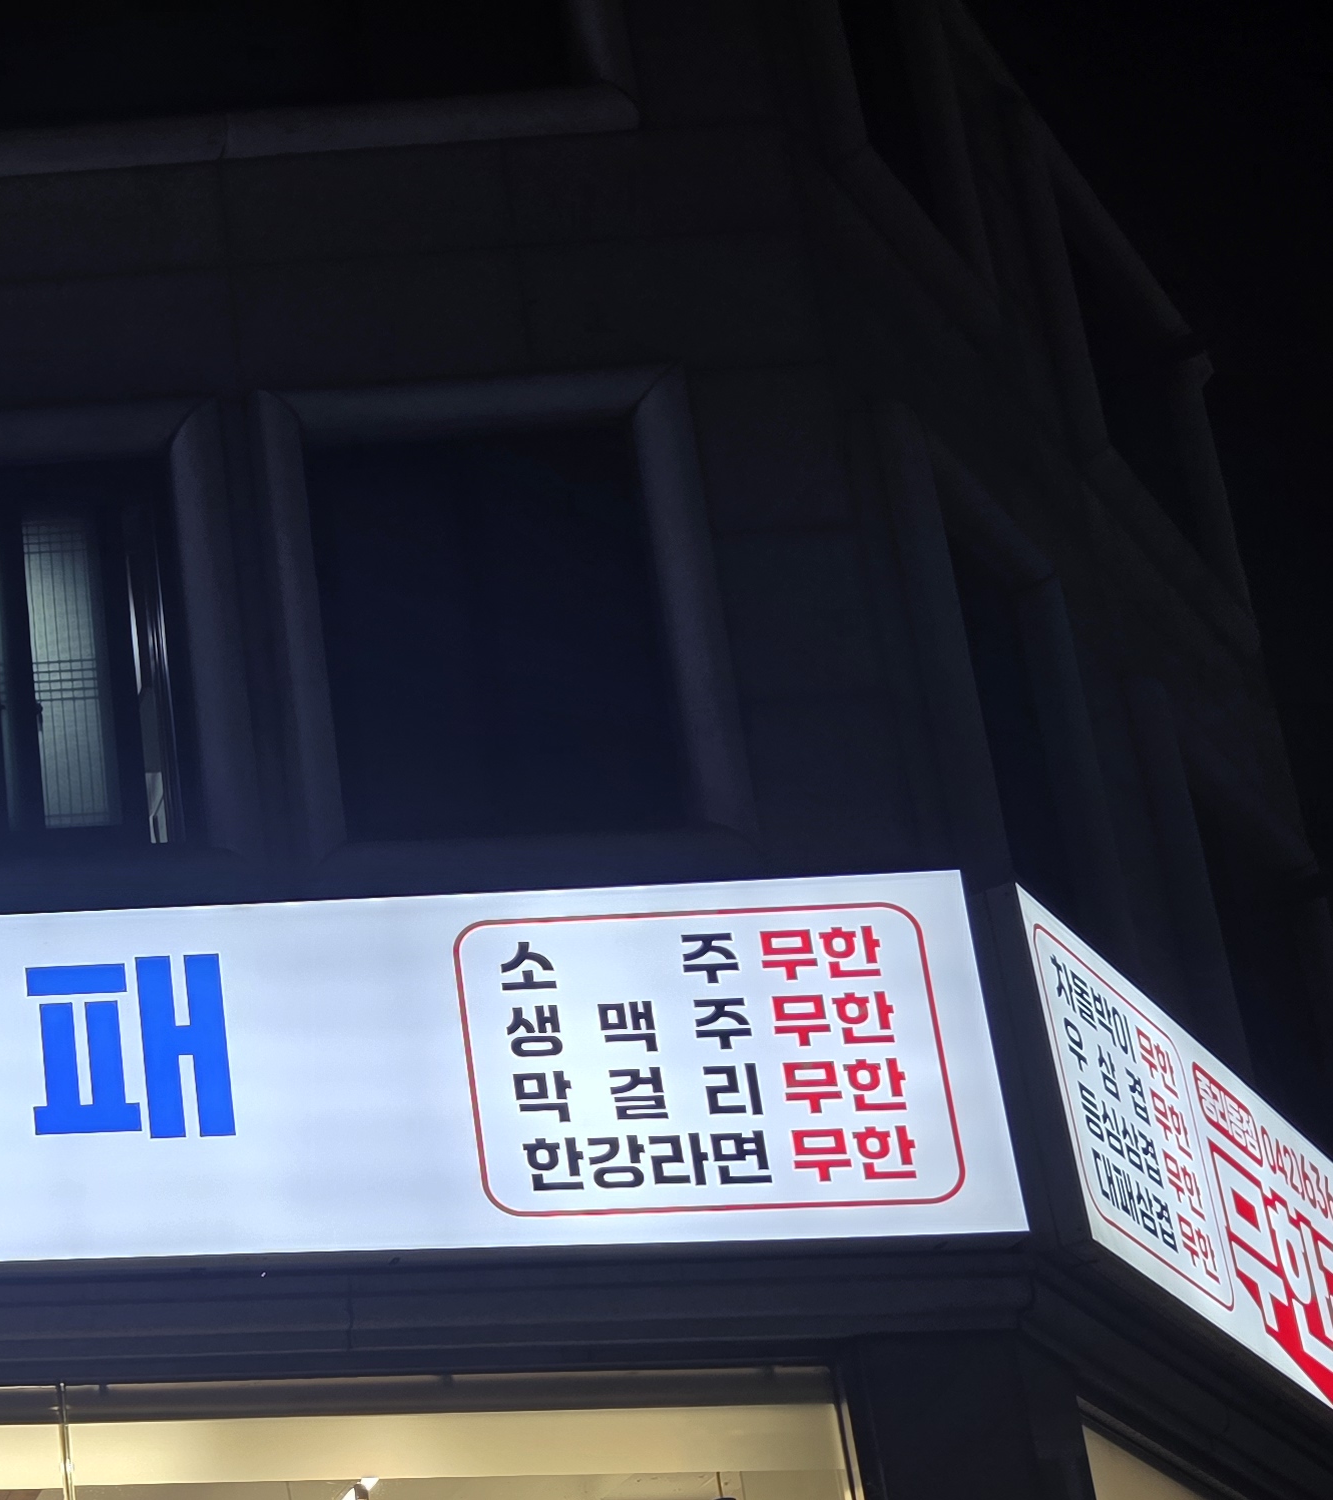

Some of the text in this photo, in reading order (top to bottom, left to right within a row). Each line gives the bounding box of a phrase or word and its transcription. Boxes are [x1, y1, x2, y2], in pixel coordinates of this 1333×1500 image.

[759, 925, 882, 981] 무한
[771, 991, 896, 1047] 무한
[1050, 954, 1179, 1099] 차돌박이 무한
[782, 1057, 908, 1114] 무한
[1195, 1070, 1261, 1160] 중리동점
[522, 1125, 917, 1192] 한강라면 무한
[1078, 1081, 1206, 1222] 등심삼겹 무한
[1149, 1087, 1193, 1161] 무한
[1091, 1147, 1220, 1285] 대패삼겹 무한
